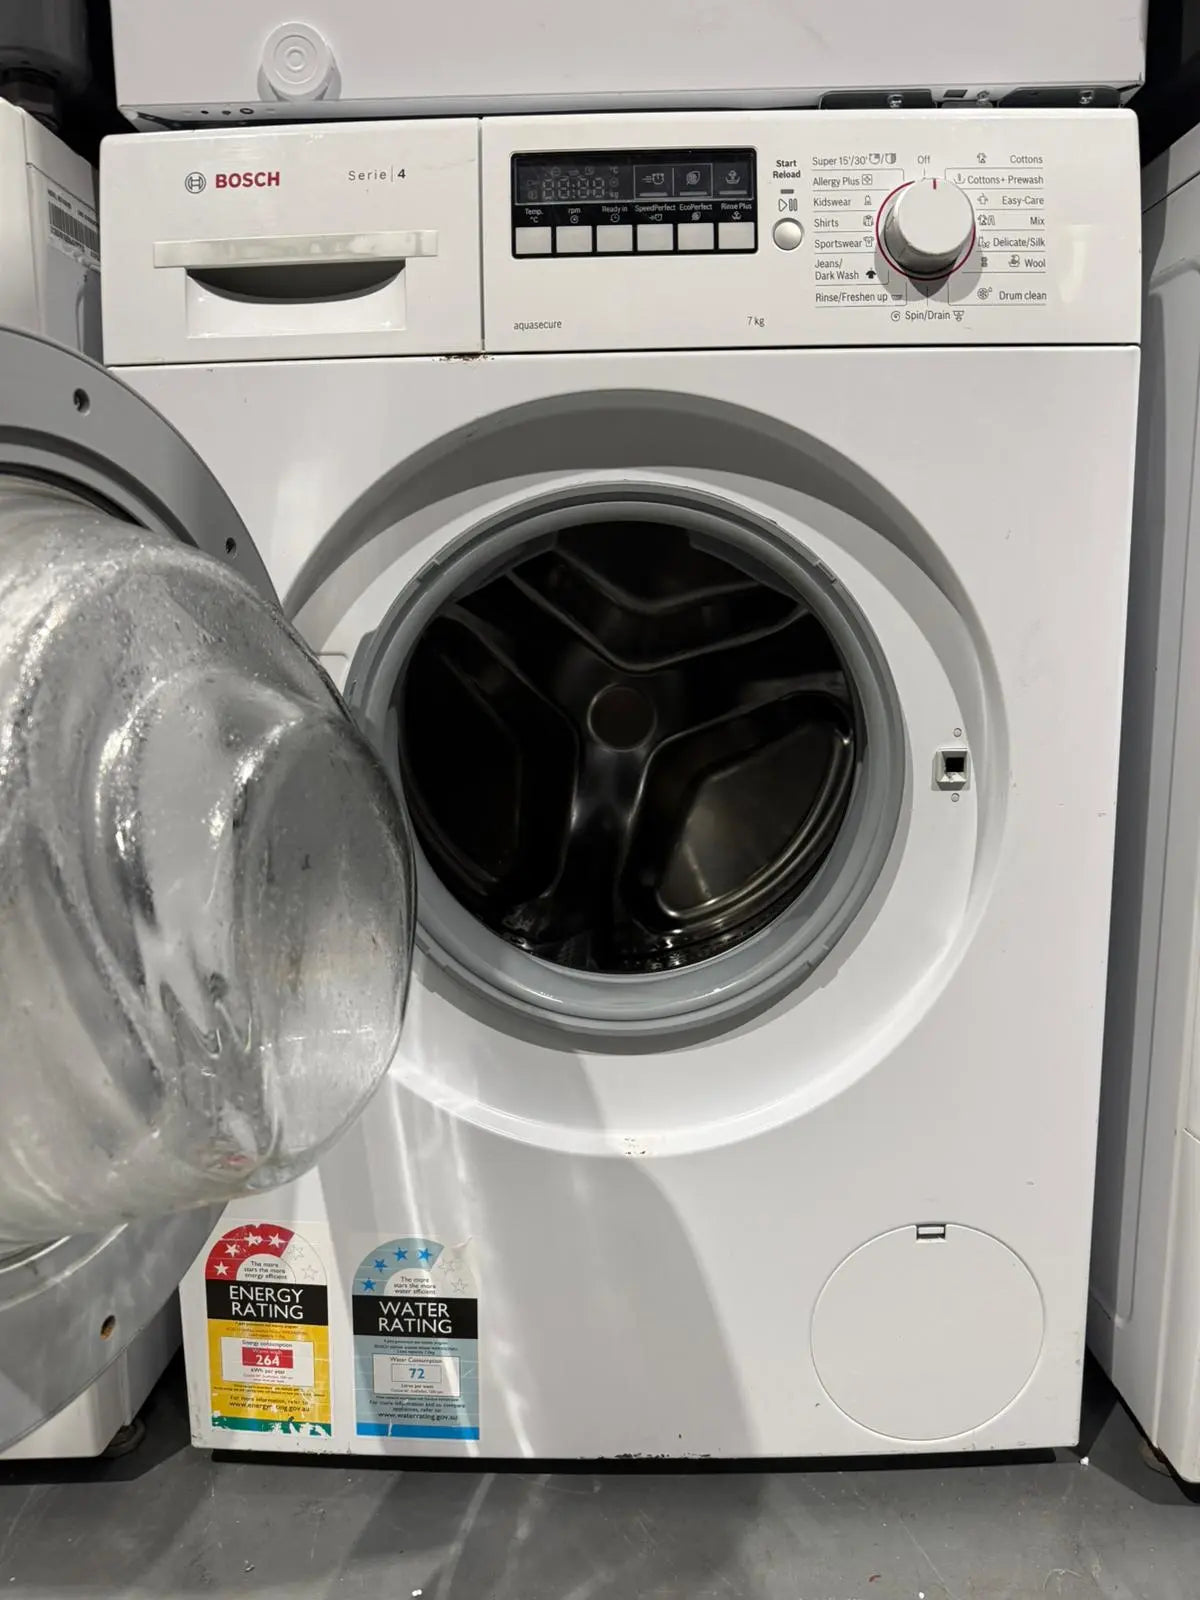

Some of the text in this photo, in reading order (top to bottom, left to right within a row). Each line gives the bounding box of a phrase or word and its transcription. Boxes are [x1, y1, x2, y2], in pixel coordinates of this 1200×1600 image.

[776, 159, 797, 168] Start
[812, 157, 837, 166] Super
[918, 155, 930, 164] Off
[1010, 154, 1043, 164] Cottons
[215, 171, 280, 189] BOSCH
[348, 168, 406, 181] Serie 4
[773, 170, 800, 179] Reload
[967, 174, 1044, 184] Cottons+ Prewash
[813, 176, 860, 188] Allergy Plus
[739, 202, 752, 210] Plus
[813, 197, 851, 207] Kidswear
[1002, 196, 1044, 207] Easy-Care
[602, 206, 620, 214] Ready
[635, 204, 676, 212] SpeedPerfect
[814, 218, 839, 228] Shirts
[1030, 217, 1045, 226] Mix
[814, 239, 862, 249] Sportswear
[993, 237, 1045, 248] Delicate/Silk
[814, 258, 843, 269] Jeans/
[1024, 258, 1046, 268] Wool
[815, 270, 859, 281] Dark Wash
[815, 292, 888, 303] Rinse/Freshen up
[1000, 291, 1047, 300] Drum clean
[905, 310, 950, 321] Spin/Drain
[513, 320, 562, 331] aquasecure
[747, 316, 765, 327] 7 kg
[229, 1285, 303, 1303] ENERGY
[231, 1301, 304, 1319] RATING
[379, 1301, 450, 1318] WATER
[379, 1318, 452, 1334] RATING
[256, 1354, 280, 1366] 264
[409, 1368, 424, 1379] 72
